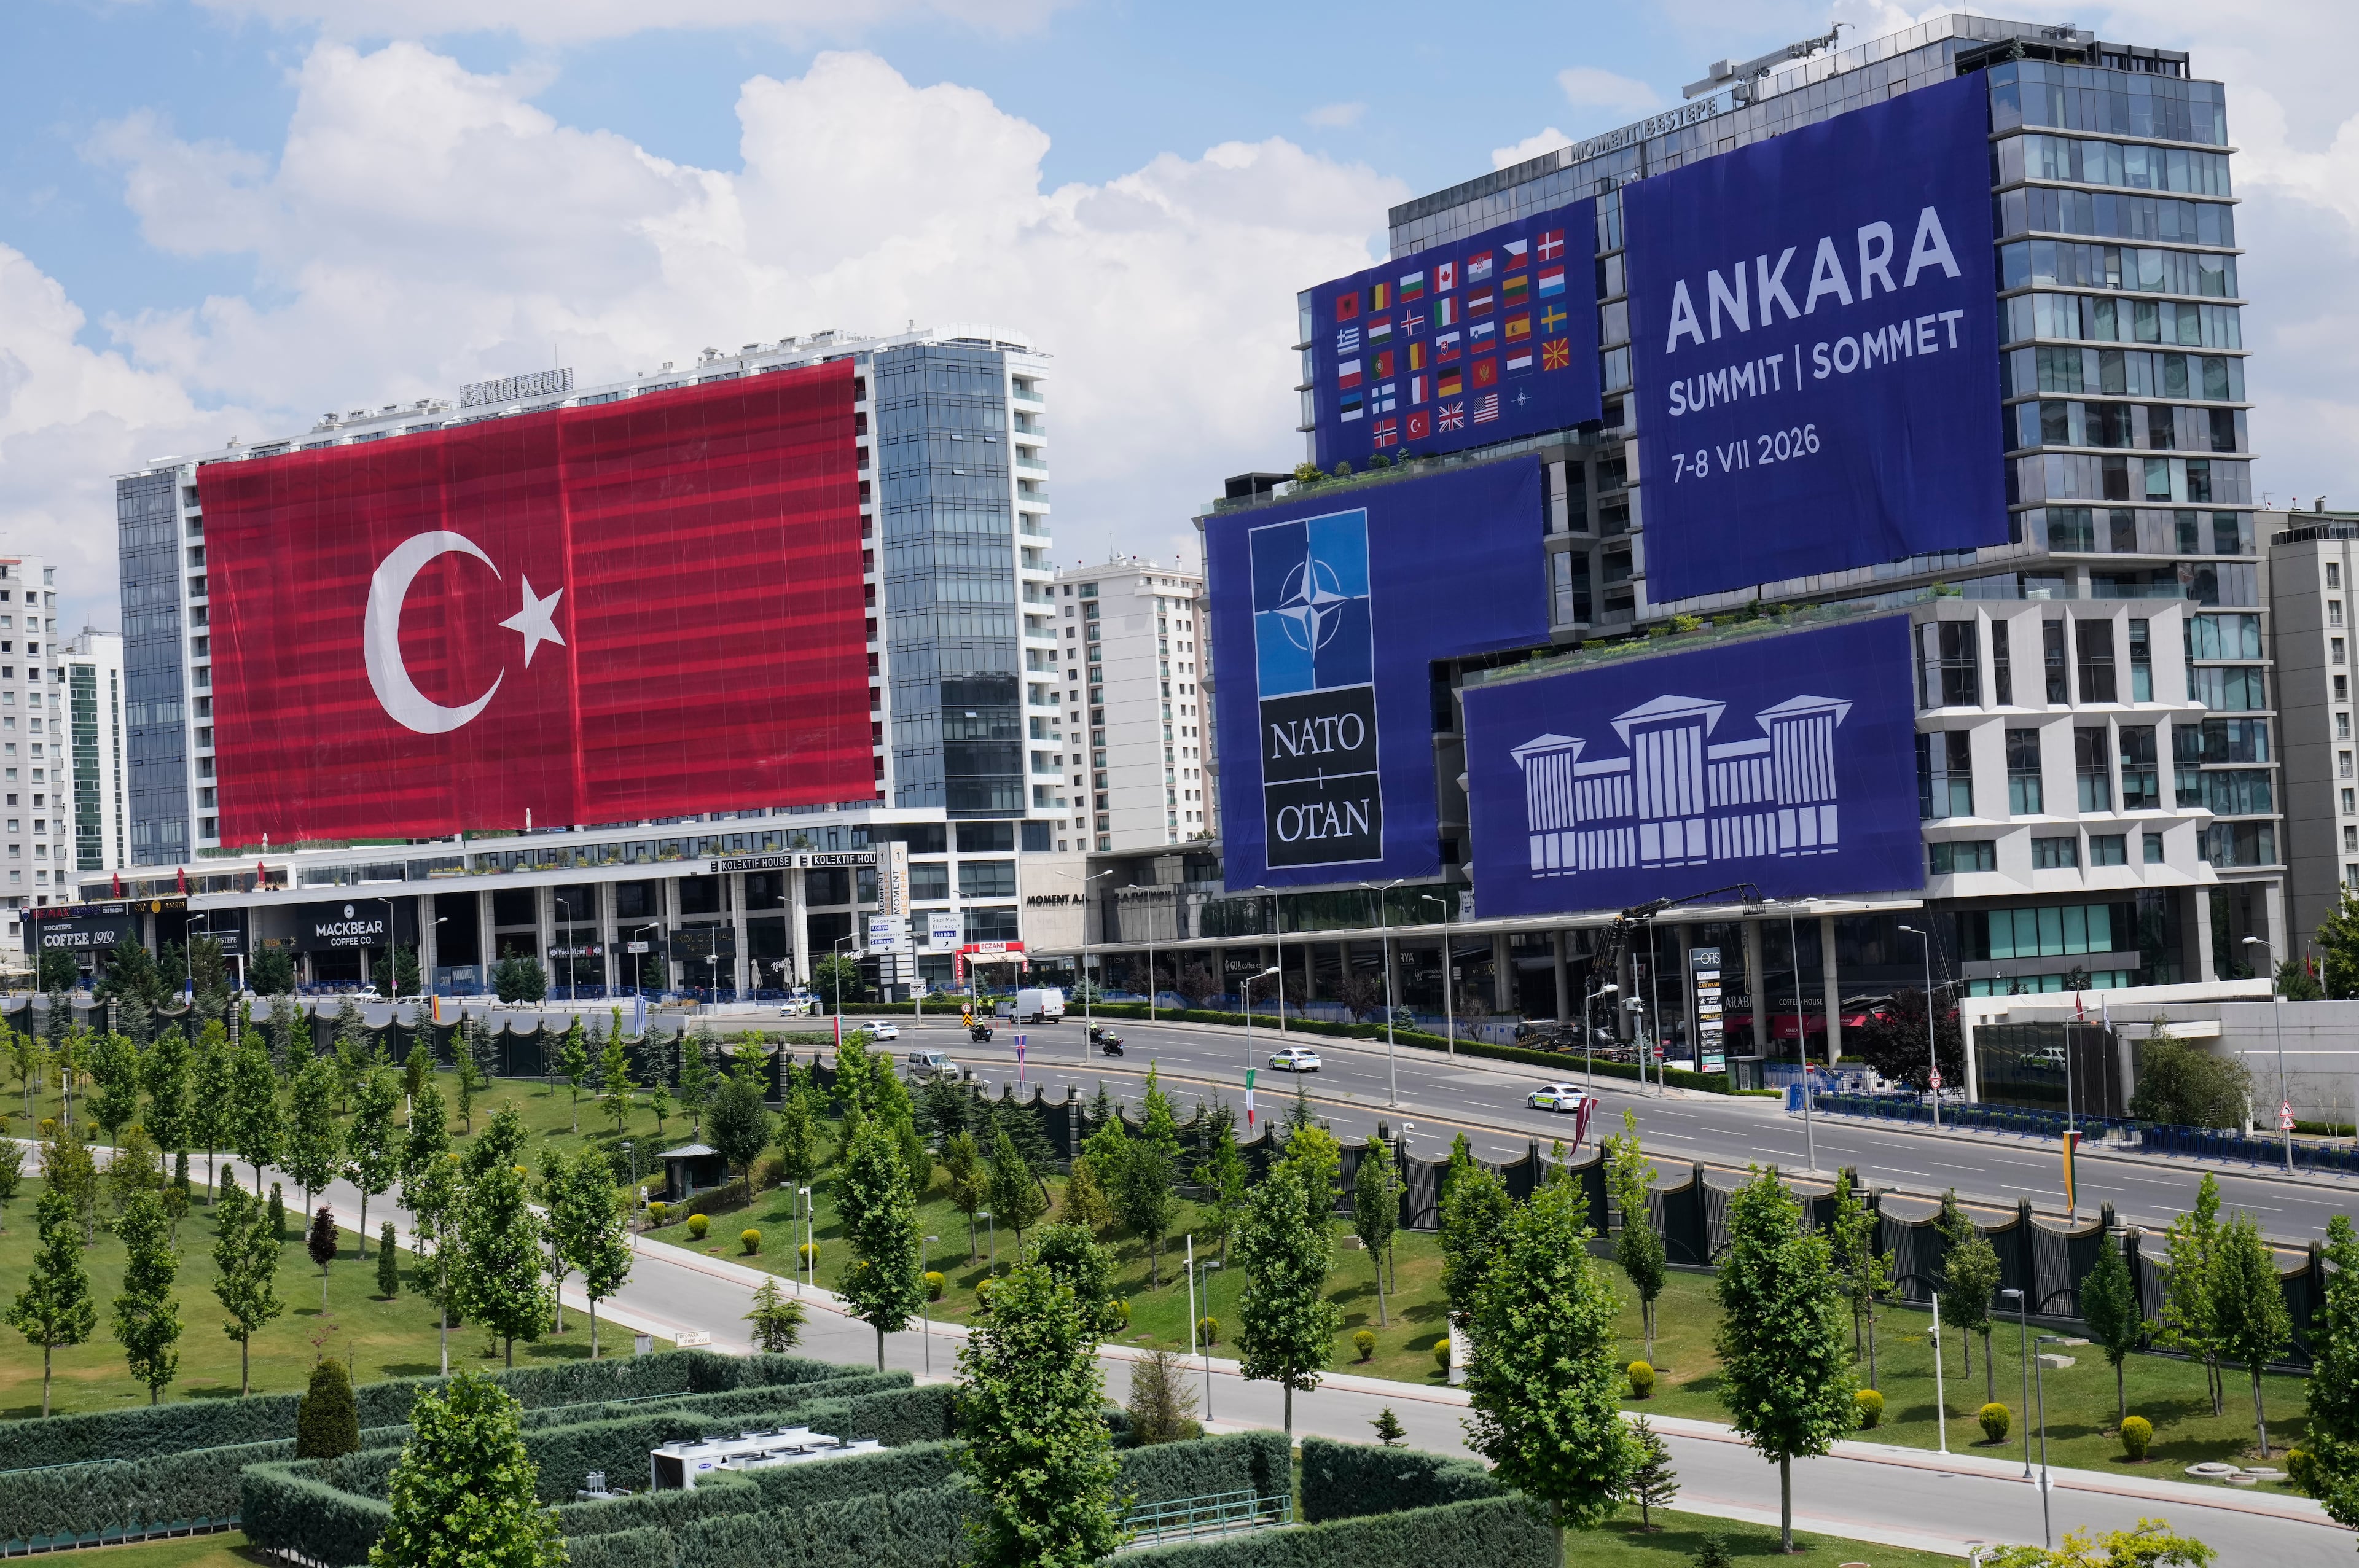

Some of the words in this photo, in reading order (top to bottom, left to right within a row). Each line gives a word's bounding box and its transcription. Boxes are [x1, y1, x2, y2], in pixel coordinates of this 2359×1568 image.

[1571, 123, 1639, 162] MOMENT
[1646, 97, 1716, 136] BEŞTEPE
[1665, 205, 1962, 354] ANKARA
[1668, 353, 1783, 417] SUMMIT
[1812, 309, 1964, 380] SOMMET
[464, 372, 565, 406] ÇAKIROĞLU
[1672, 448, 1709, 483] 7-8
[1716, 439, 1750, 473] VII
[1758, 423, 1820, 465] 2026
[1270, 712, 1365, 759] NATO
[1276, 798, 1370, 842] OTAN
[762, 856, 789, 868] HOUSE
[858, 854, 876, 864] HOU
[1027, 894, 1069, 907] MOMENT
[44, 923, 72, 932] KOCATEPE
[316, 920, 383, 937] MACKBEAR
[44, 932, 89, 948] COFFEE
[331, 937, 359, 946] COFFEE
[360, 936, 374, 945] CO.
[1230, 961, 1242, 970] GUA
[1724, 996, 1752, 1011] ARABI
